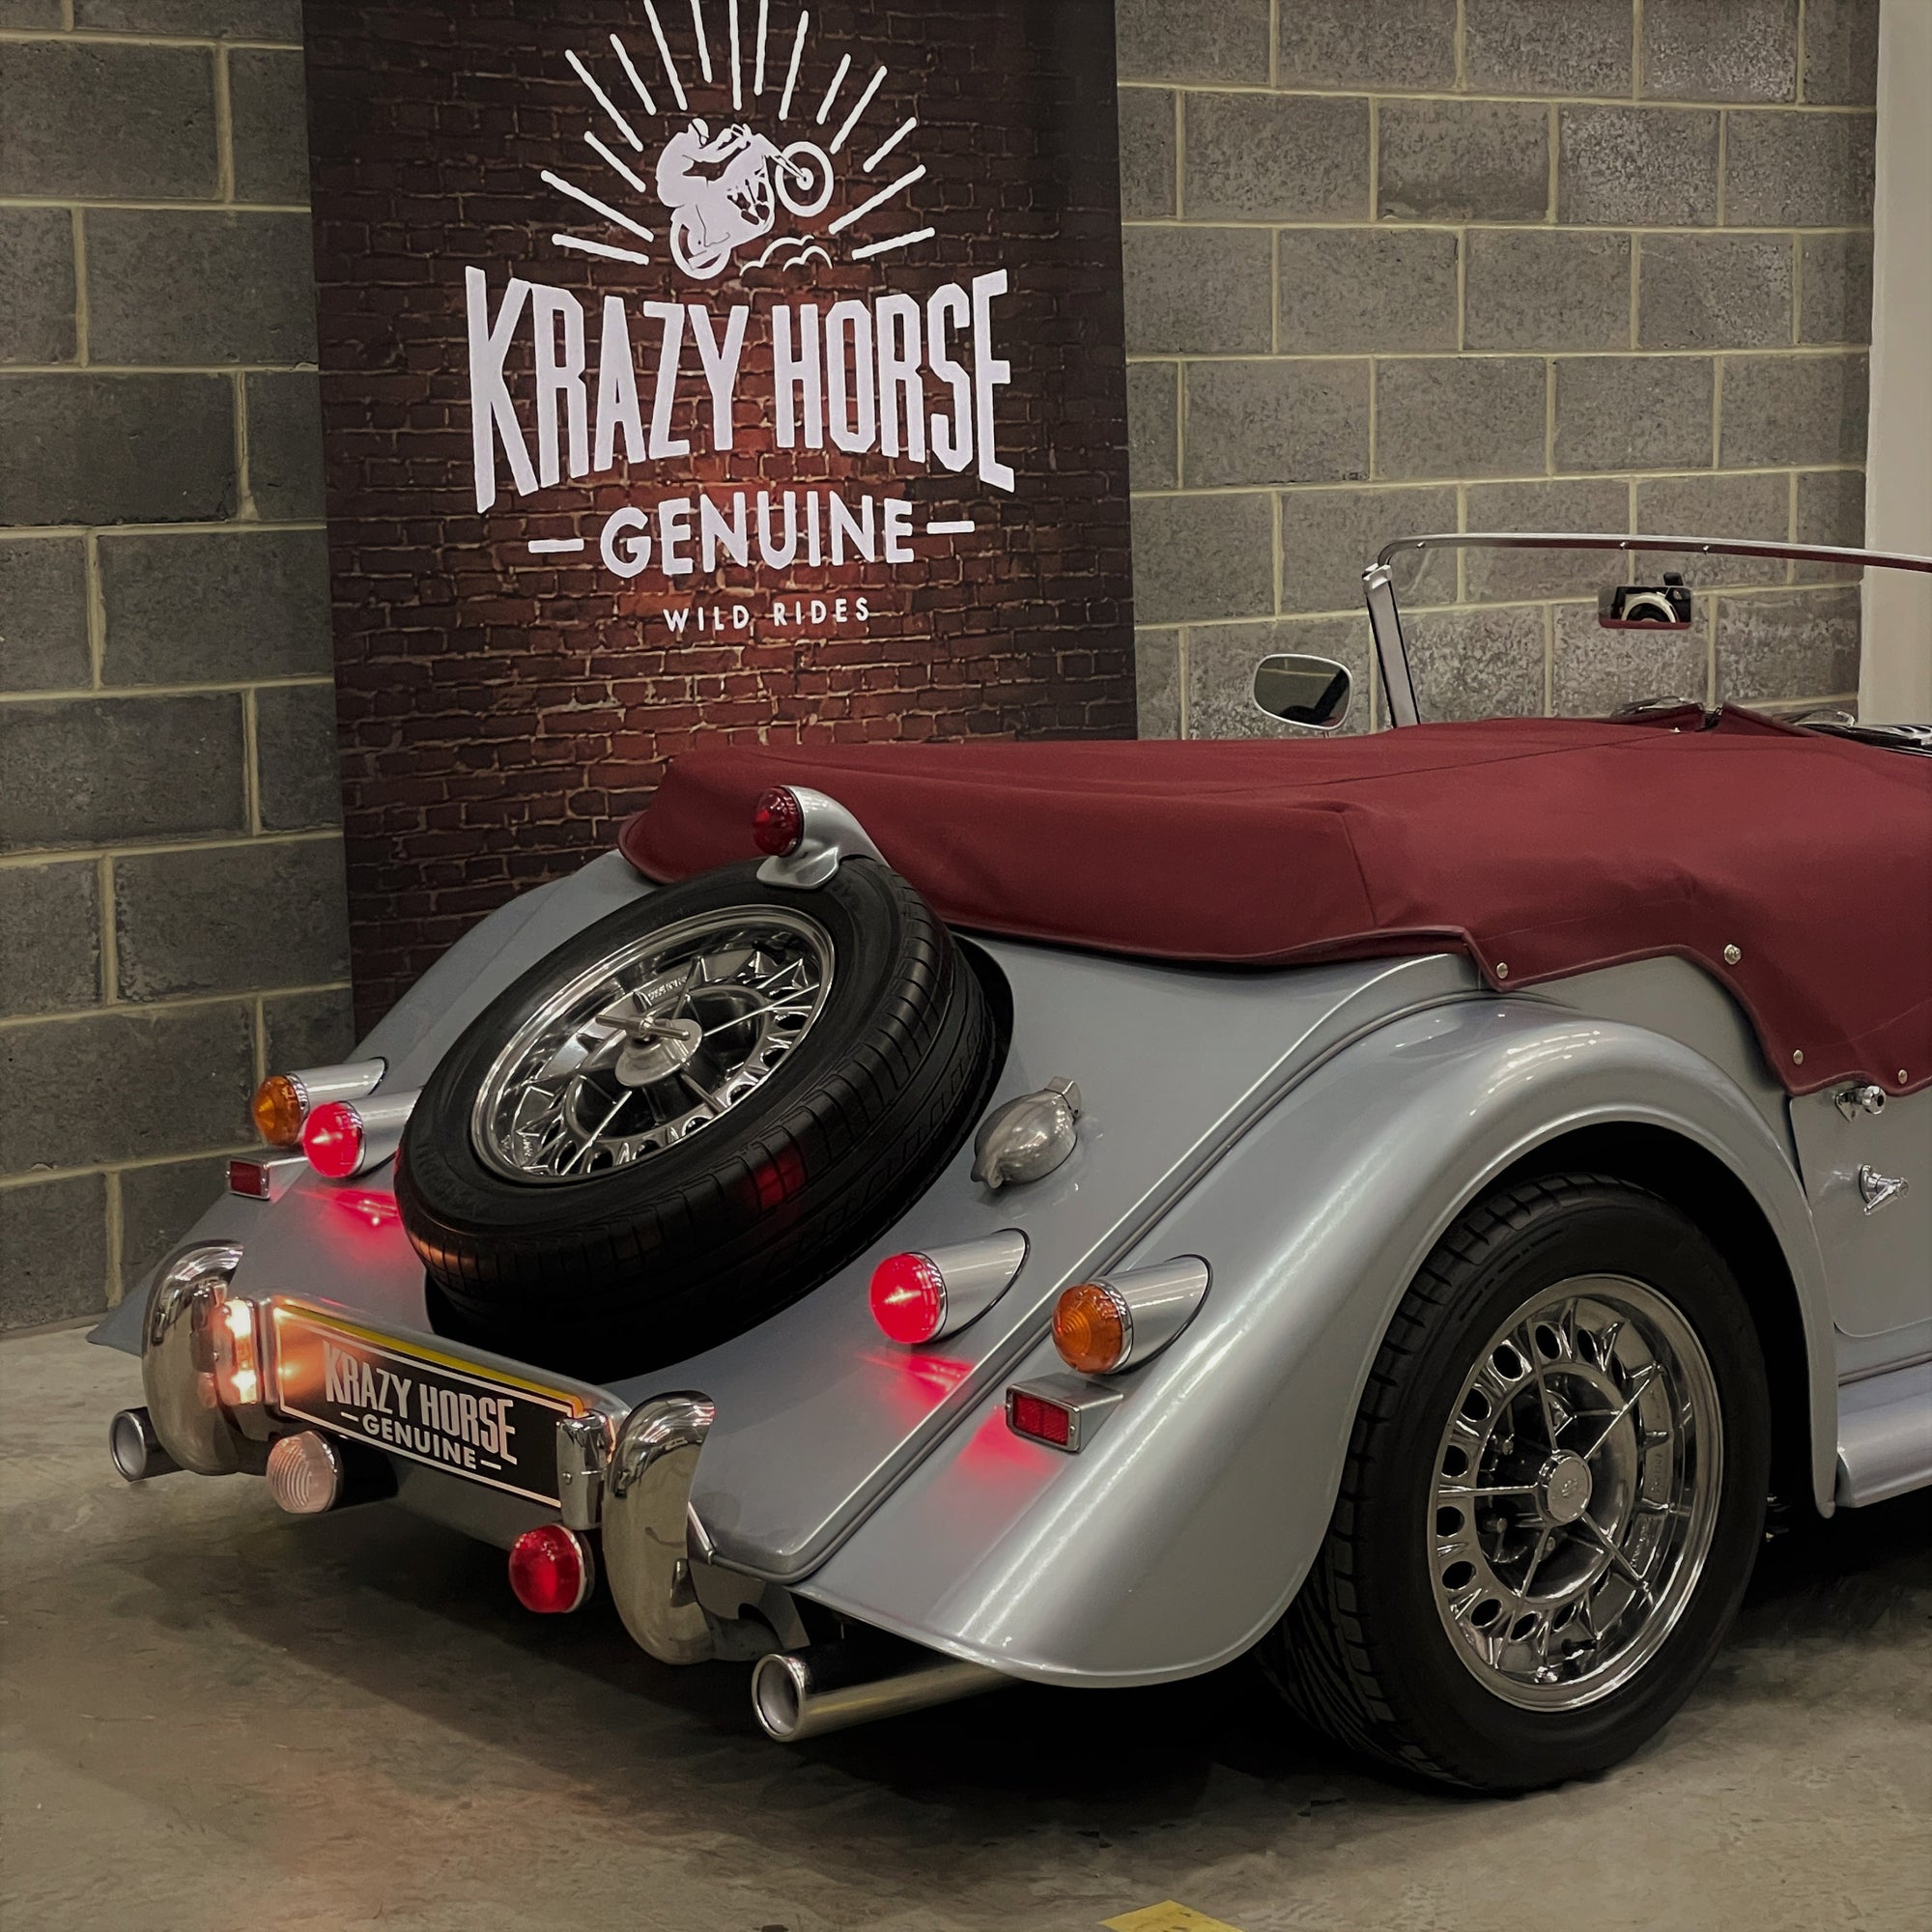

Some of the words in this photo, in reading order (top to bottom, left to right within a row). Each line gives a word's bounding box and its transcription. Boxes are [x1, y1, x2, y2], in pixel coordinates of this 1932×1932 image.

[465, 266, 749, 514] KRAZY
[772, 269, 1014, 493] HORSE
[600, 490, 914, 578] GENUINE
[663, 605, 750, 633] WILD
[774, 597, 869, 626] RIDES
[322, 1339, 412, 1419] KRAZY
[419, 1383, 518, 1465] HORSE
[362, 1413, 476, 1469] GENUINE
